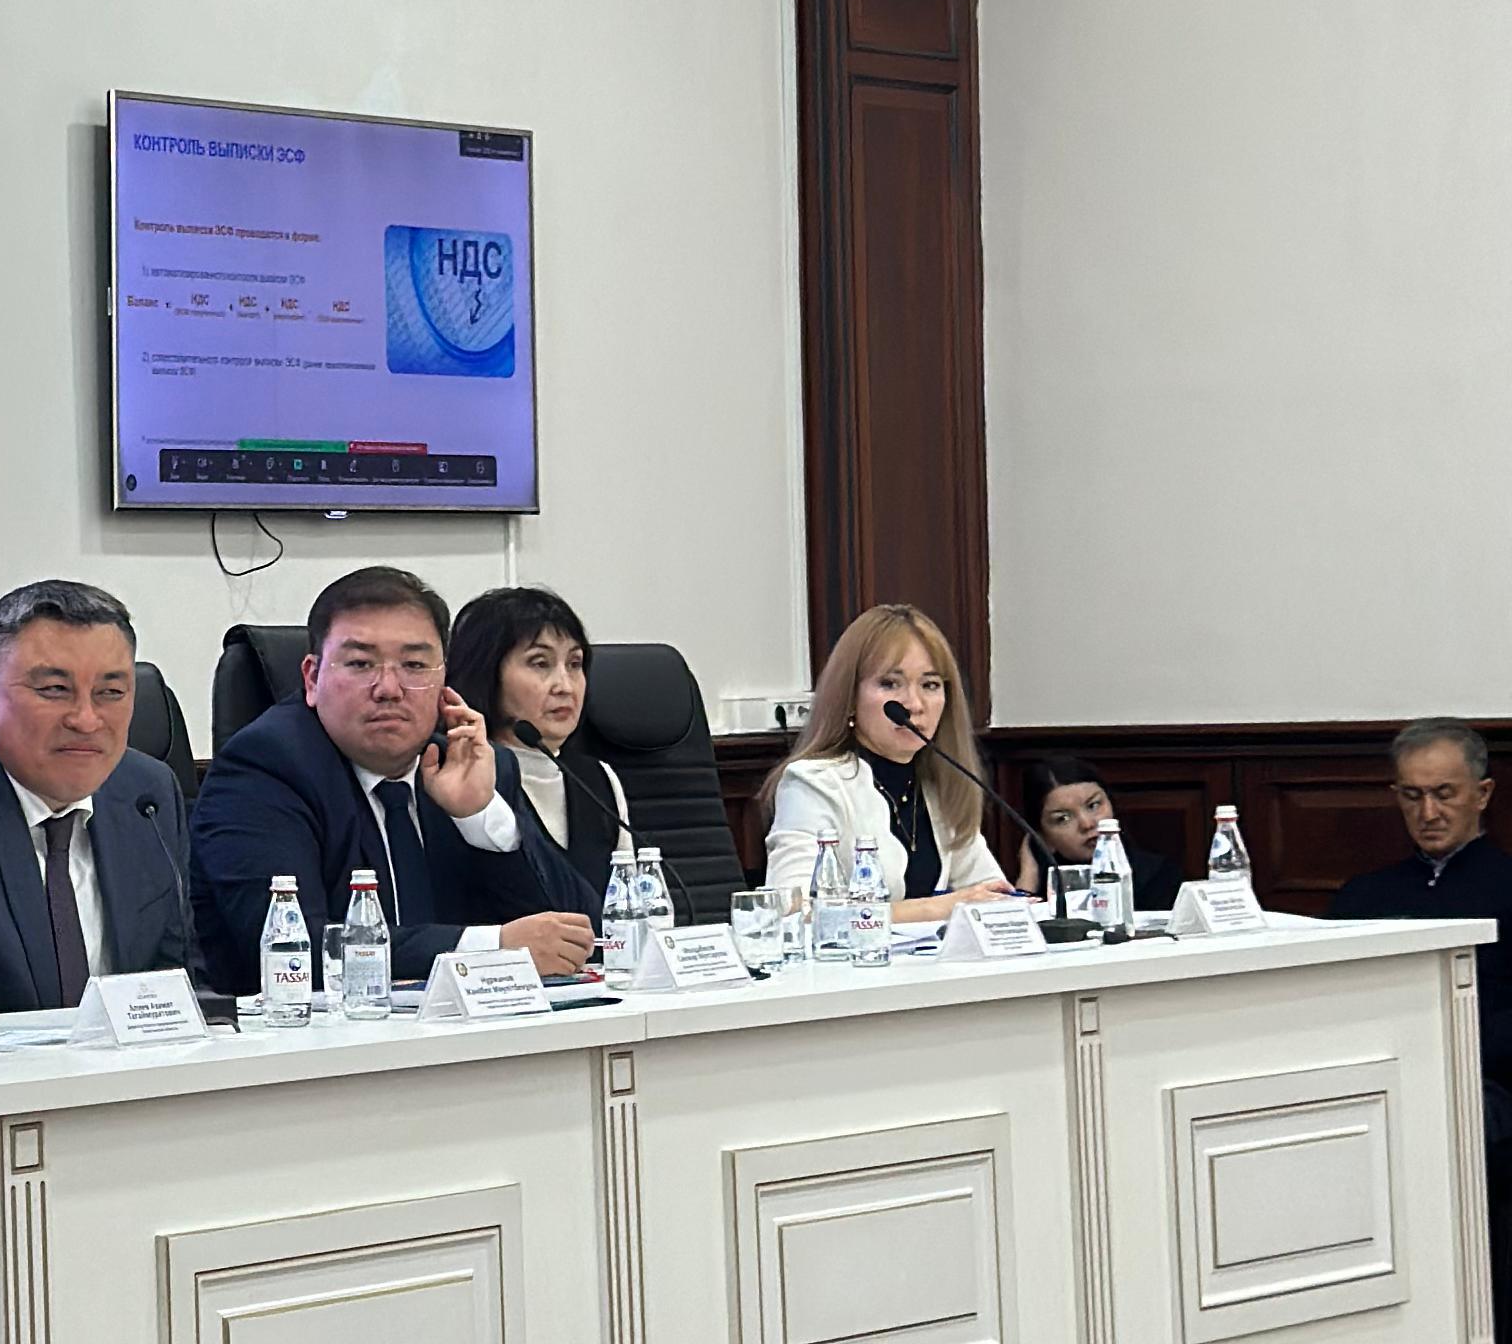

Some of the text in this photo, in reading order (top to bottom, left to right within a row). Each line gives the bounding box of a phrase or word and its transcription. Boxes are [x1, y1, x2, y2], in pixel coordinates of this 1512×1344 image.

[133, 133, 306, 164] КОНТРОЛЬ ВЫПИСКИ ЭСФ
[436, 237, 503, 285] НДС
